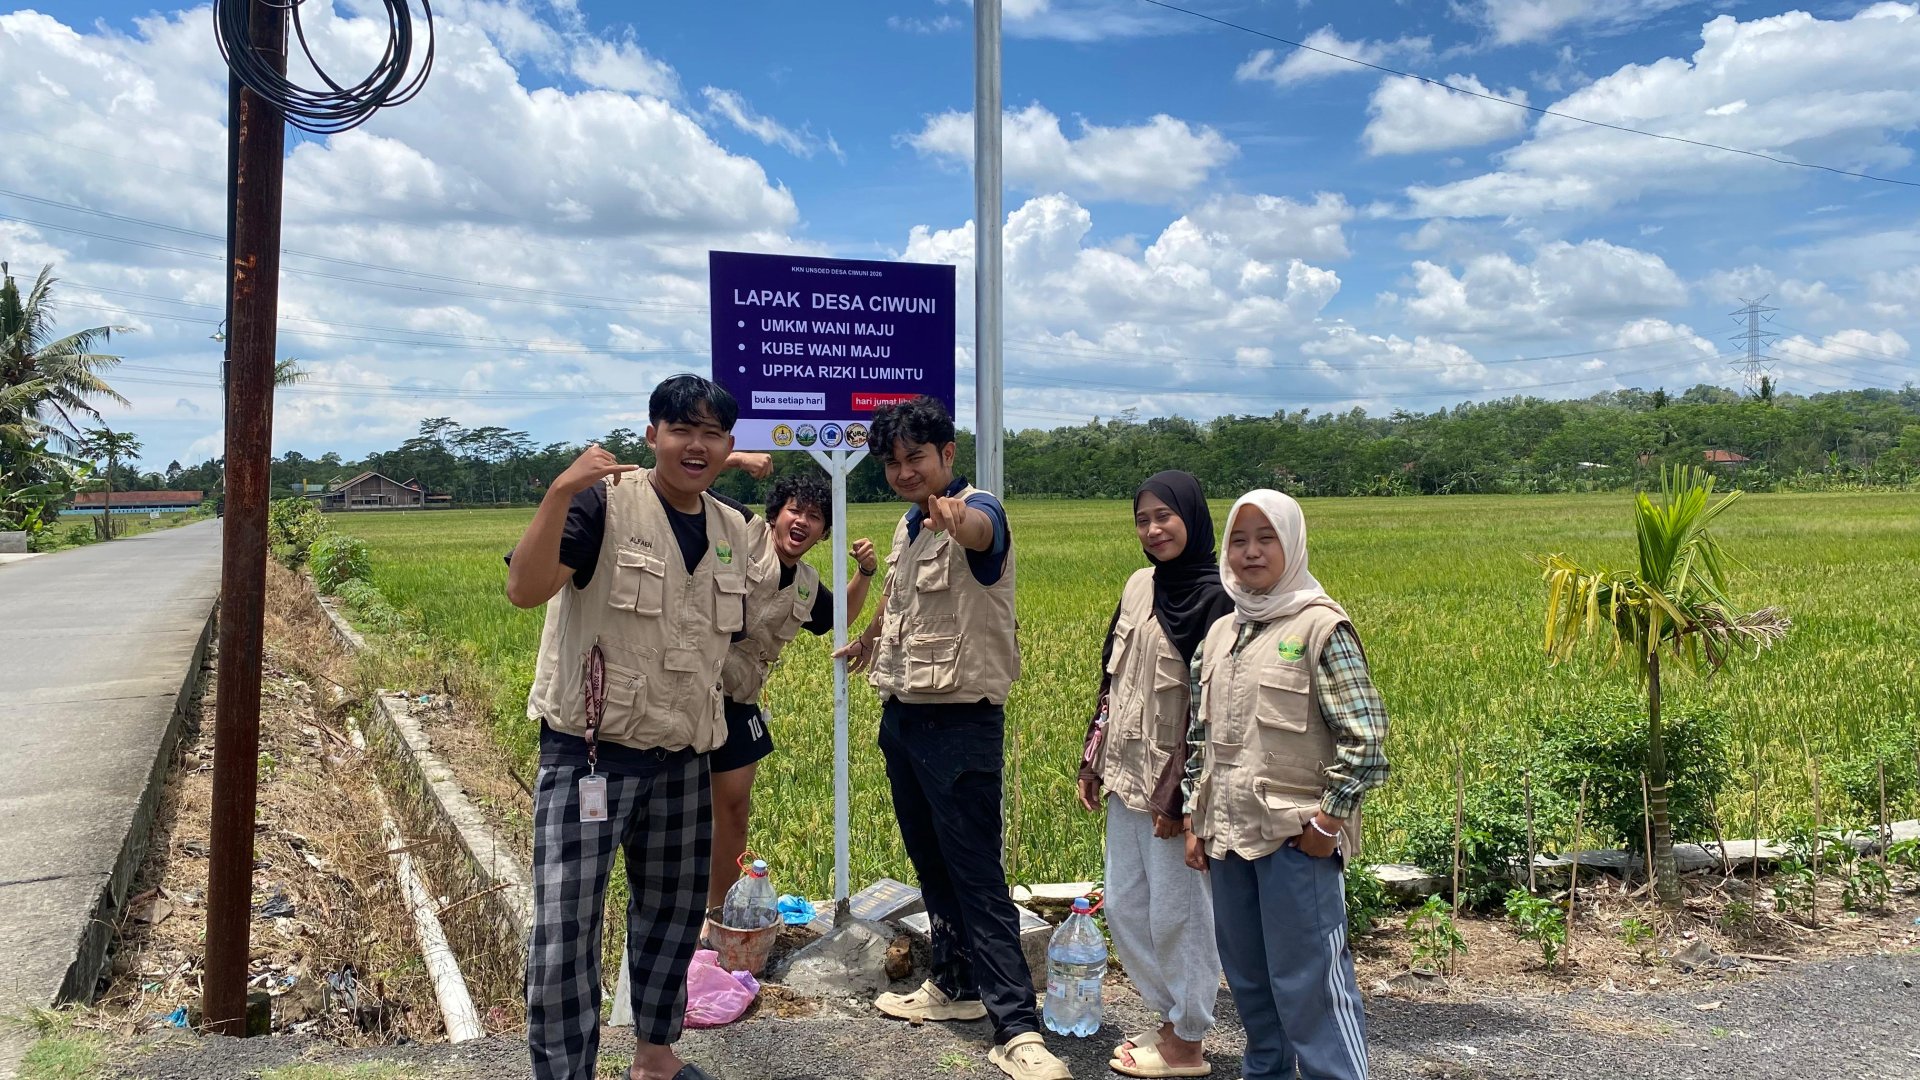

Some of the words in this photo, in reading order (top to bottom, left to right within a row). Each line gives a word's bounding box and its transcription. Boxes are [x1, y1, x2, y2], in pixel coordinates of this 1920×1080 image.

[734, 288, 800, 308] LAPAK
[811, 292, 864, 311] DESA
[869, 296, 936, 314] CIWUNI
[761, 318, 808, 334] UMKM
[812, 320, 850, 335] WANI
[854, 323, 895, 336] MAJU
[761, 342, 804, 356] KUBE
[808, 344, 846, 357] WANI
[850, 346, 891, 358] MAJU
[762, 364, 815, 378] UPPKA
[818, 366, 856, 379] RIZKI
[860, 367, 923, 380] LUMINTU
[754, 395, 776, 404] buka
[777, 396, 804, 405] setiap
[805, 396, 823, 405] hari
[855, 397, 873, 405] hari
[873, 398, 898, 407] jumat
[630, 536, 652, 548] ALFAEN
[748, 714, 764, 742] 10
